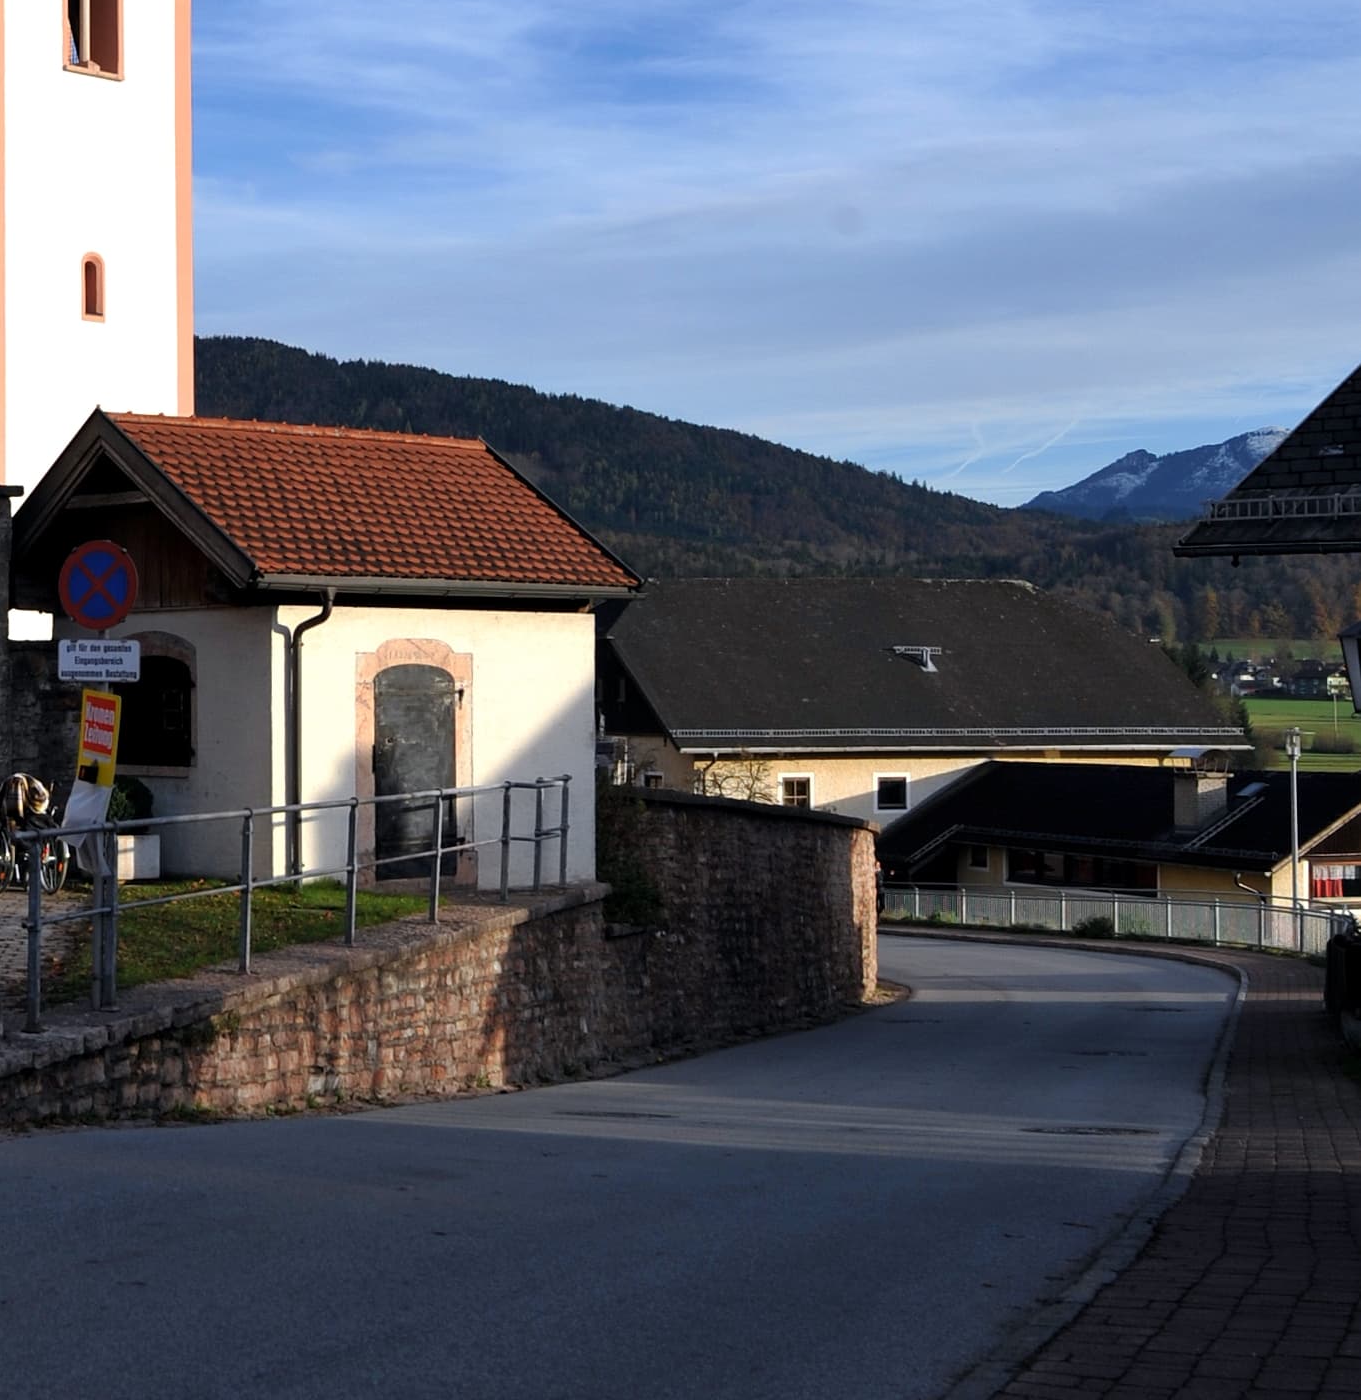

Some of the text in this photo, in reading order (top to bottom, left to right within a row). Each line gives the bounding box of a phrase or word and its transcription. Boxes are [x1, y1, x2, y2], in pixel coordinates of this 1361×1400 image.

[79, 643, 88, 652] für
[90, 644, 101, 652] den
[74, 656, 123, 666] Eingangsbereich
[86, 701, 115, 726] Kronen
[84, 722, 113, 750] Zeitung
